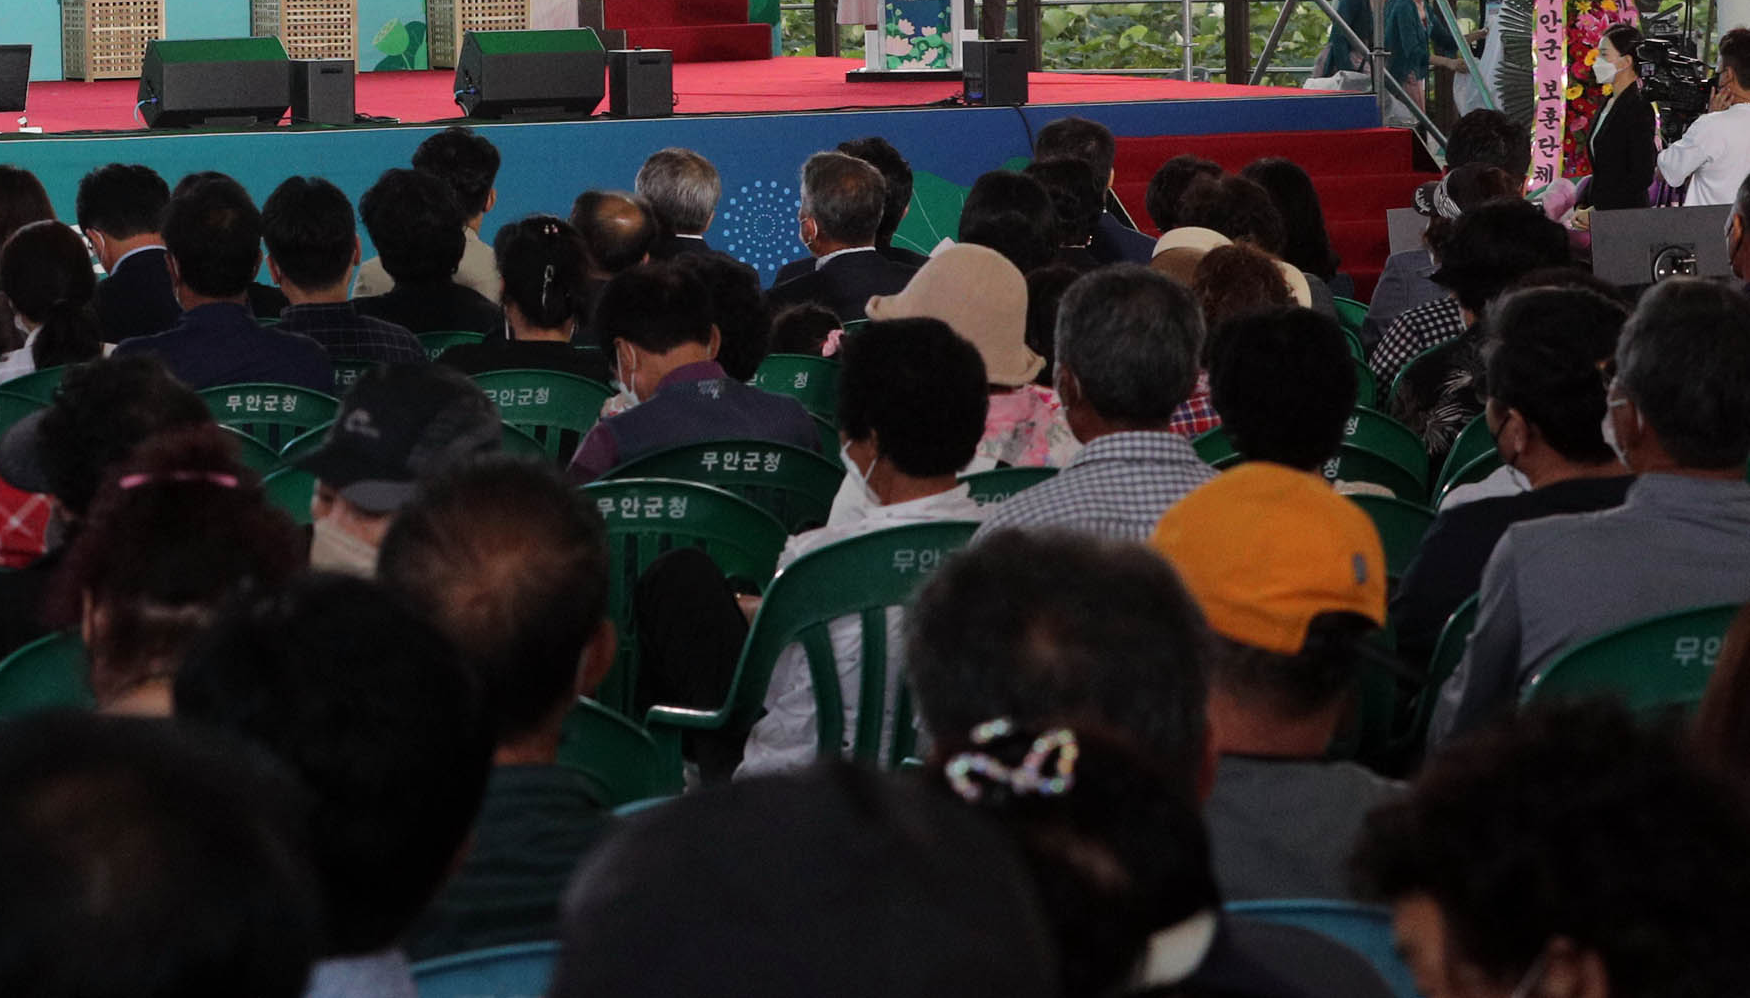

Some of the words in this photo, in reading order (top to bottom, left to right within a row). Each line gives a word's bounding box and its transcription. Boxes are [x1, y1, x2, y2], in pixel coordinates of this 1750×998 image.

[1534, 82, 1561, 183] 보훈단체
[226, 394, 298, 413] 무안군청
[701, 451, 781, 472] 무안군청
[596, 496, 688, 520] 무안군청
[892, 548, 942, 574] 무안
[1674, 636, 1723, 667] 무안
